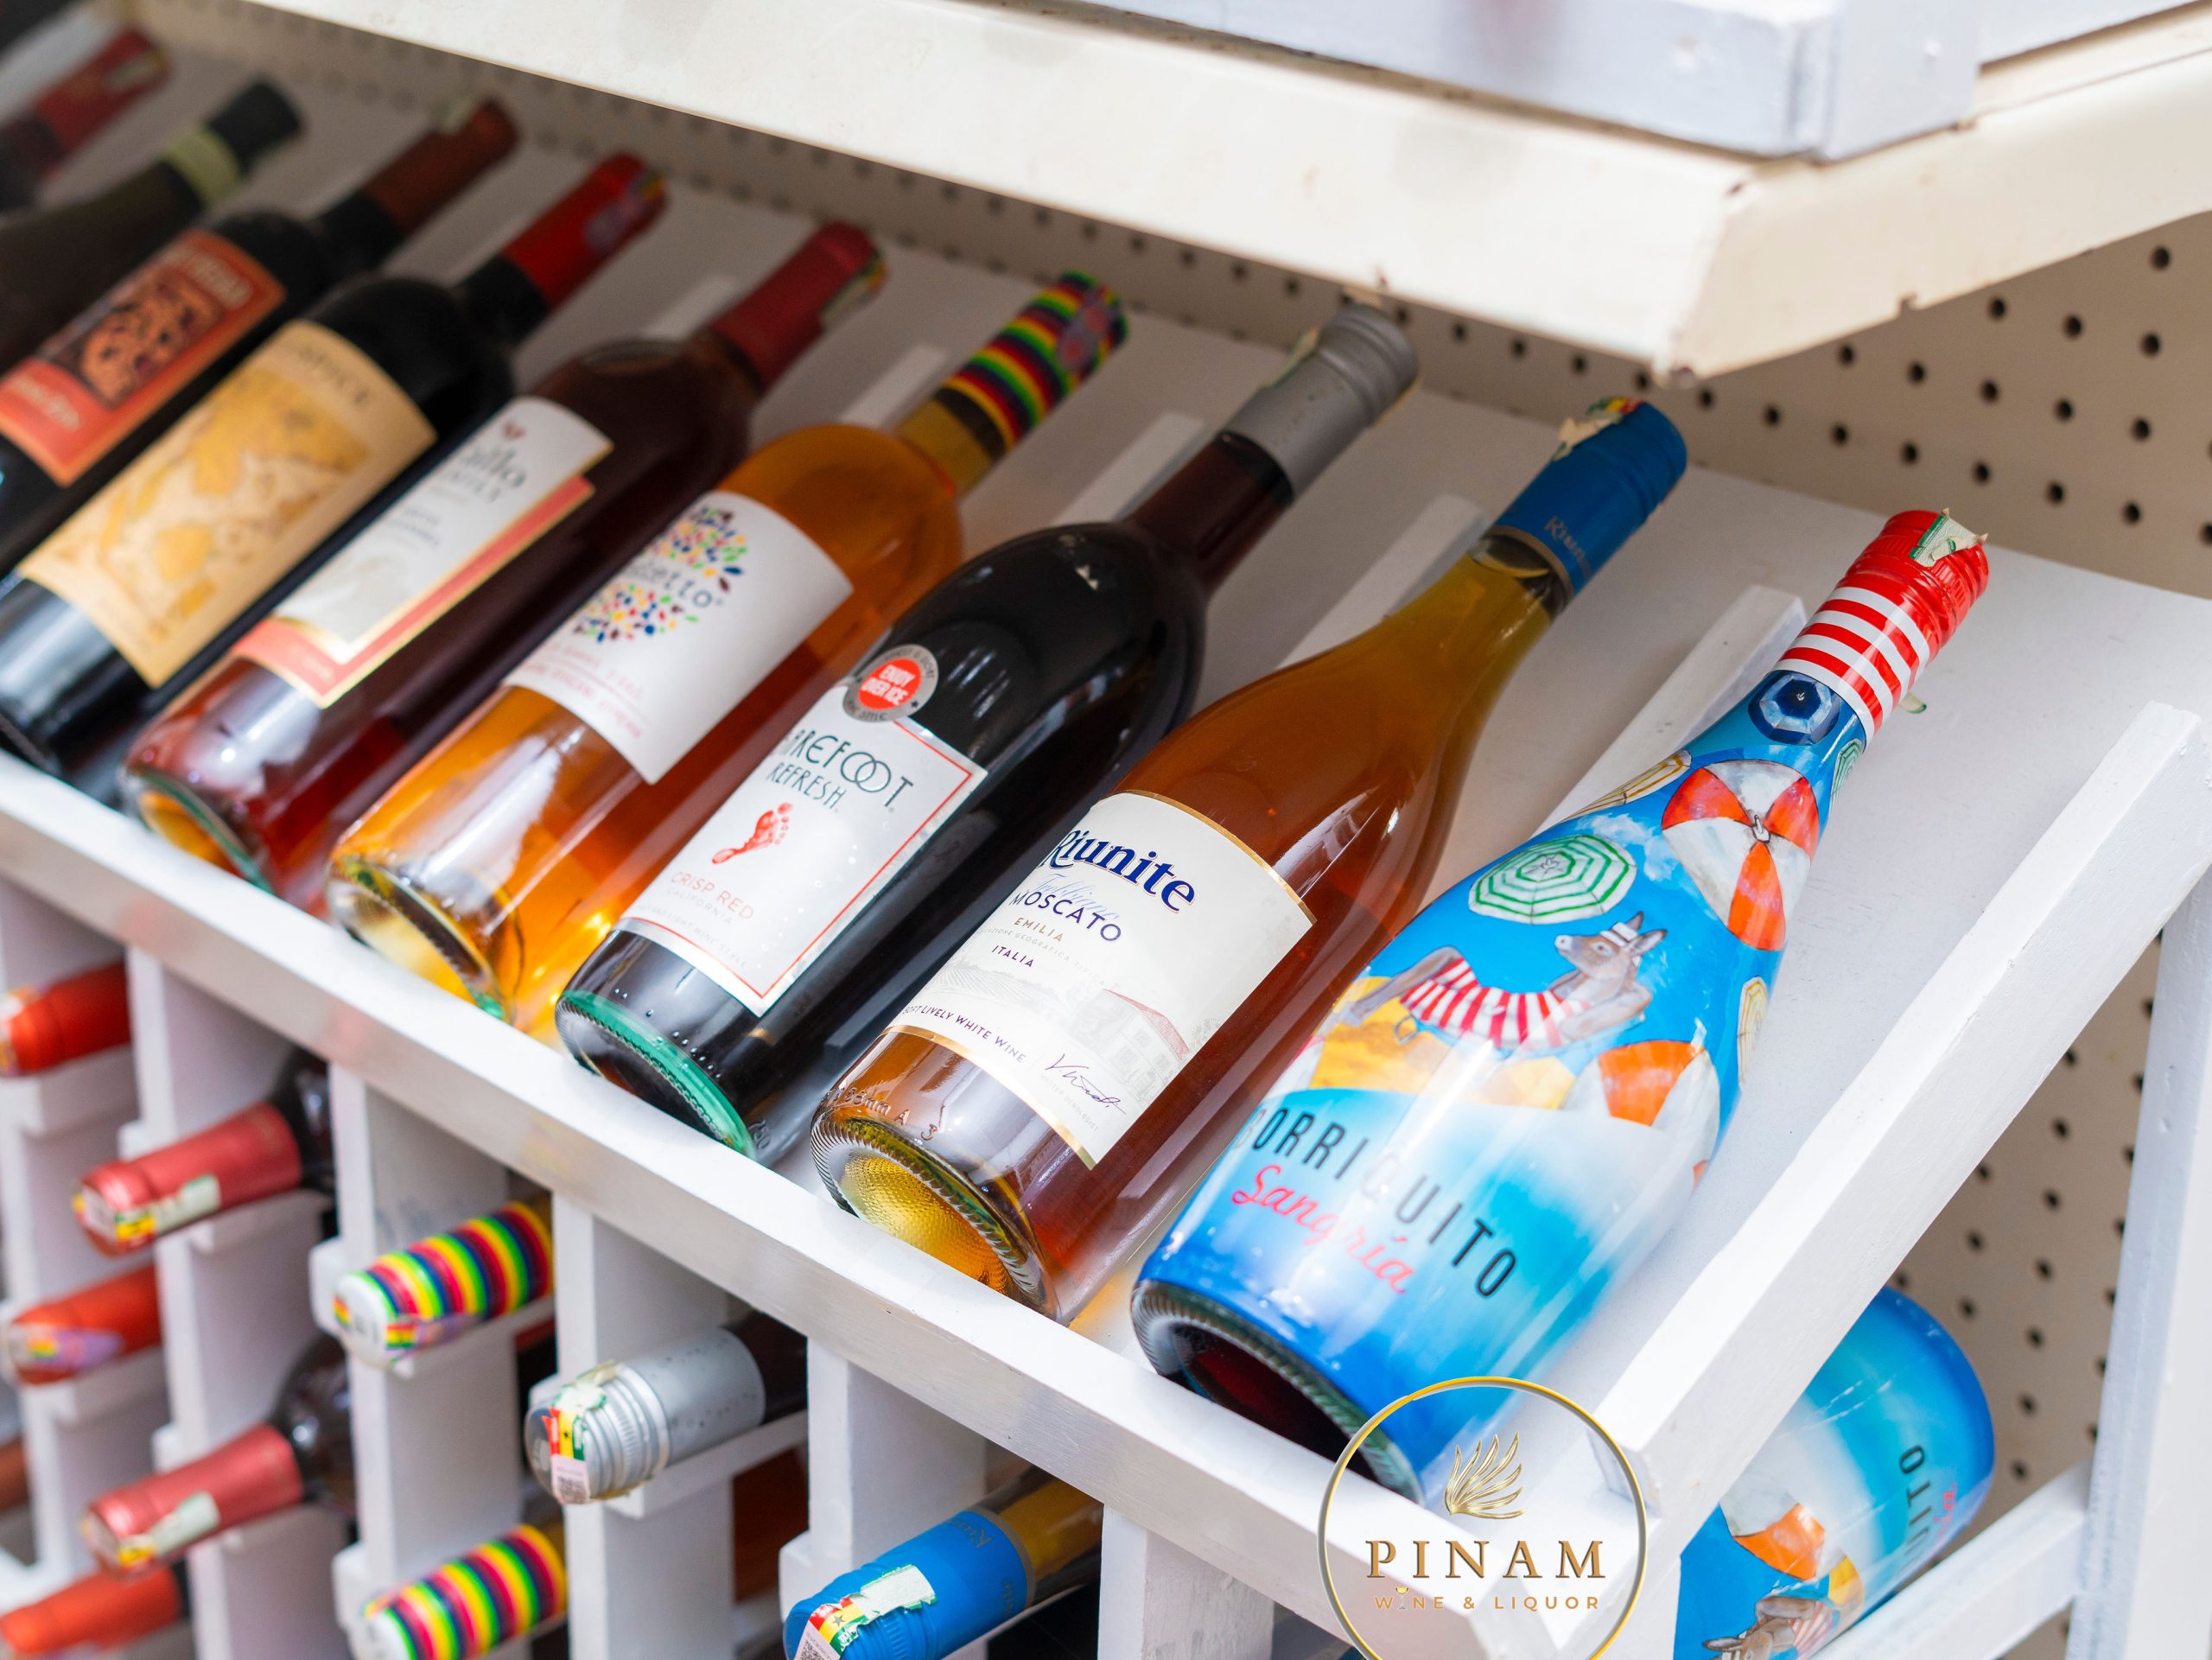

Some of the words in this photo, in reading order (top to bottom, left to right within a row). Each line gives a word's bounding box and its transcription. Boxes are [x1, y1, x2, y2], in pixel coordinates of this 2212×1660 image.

[861, 677, 892, 697] OVER
[883, 686, 909, 706] ICE
[879, 664, 916, 688] ENJOY
[766, 761, 846, 809] REFRESH
[779, 729, 913, 807] AREFOOT
[671, 871, 715, 894] CRISP
[716, 890, 754, 920] RED
[1039, 830, 1196, 914] Riunite
[666, 887, 733, 925] CALIFORNIA
[1009, 891, 1122, 942] MOSCATO
[1014, 917, 1065, 942] EMILIA
[991, 944, 1034, 968] ITALIA
[1015, 932, 1071, 961] GEOGRAFICA
[921, 1005, 954, 1020] LIVELY
[956, 1014, 993, 1040] WHITE
[995, 1036, 1027, 1063] WINE
[1234, 1108, 1516, 1298] BORRIQUITO
